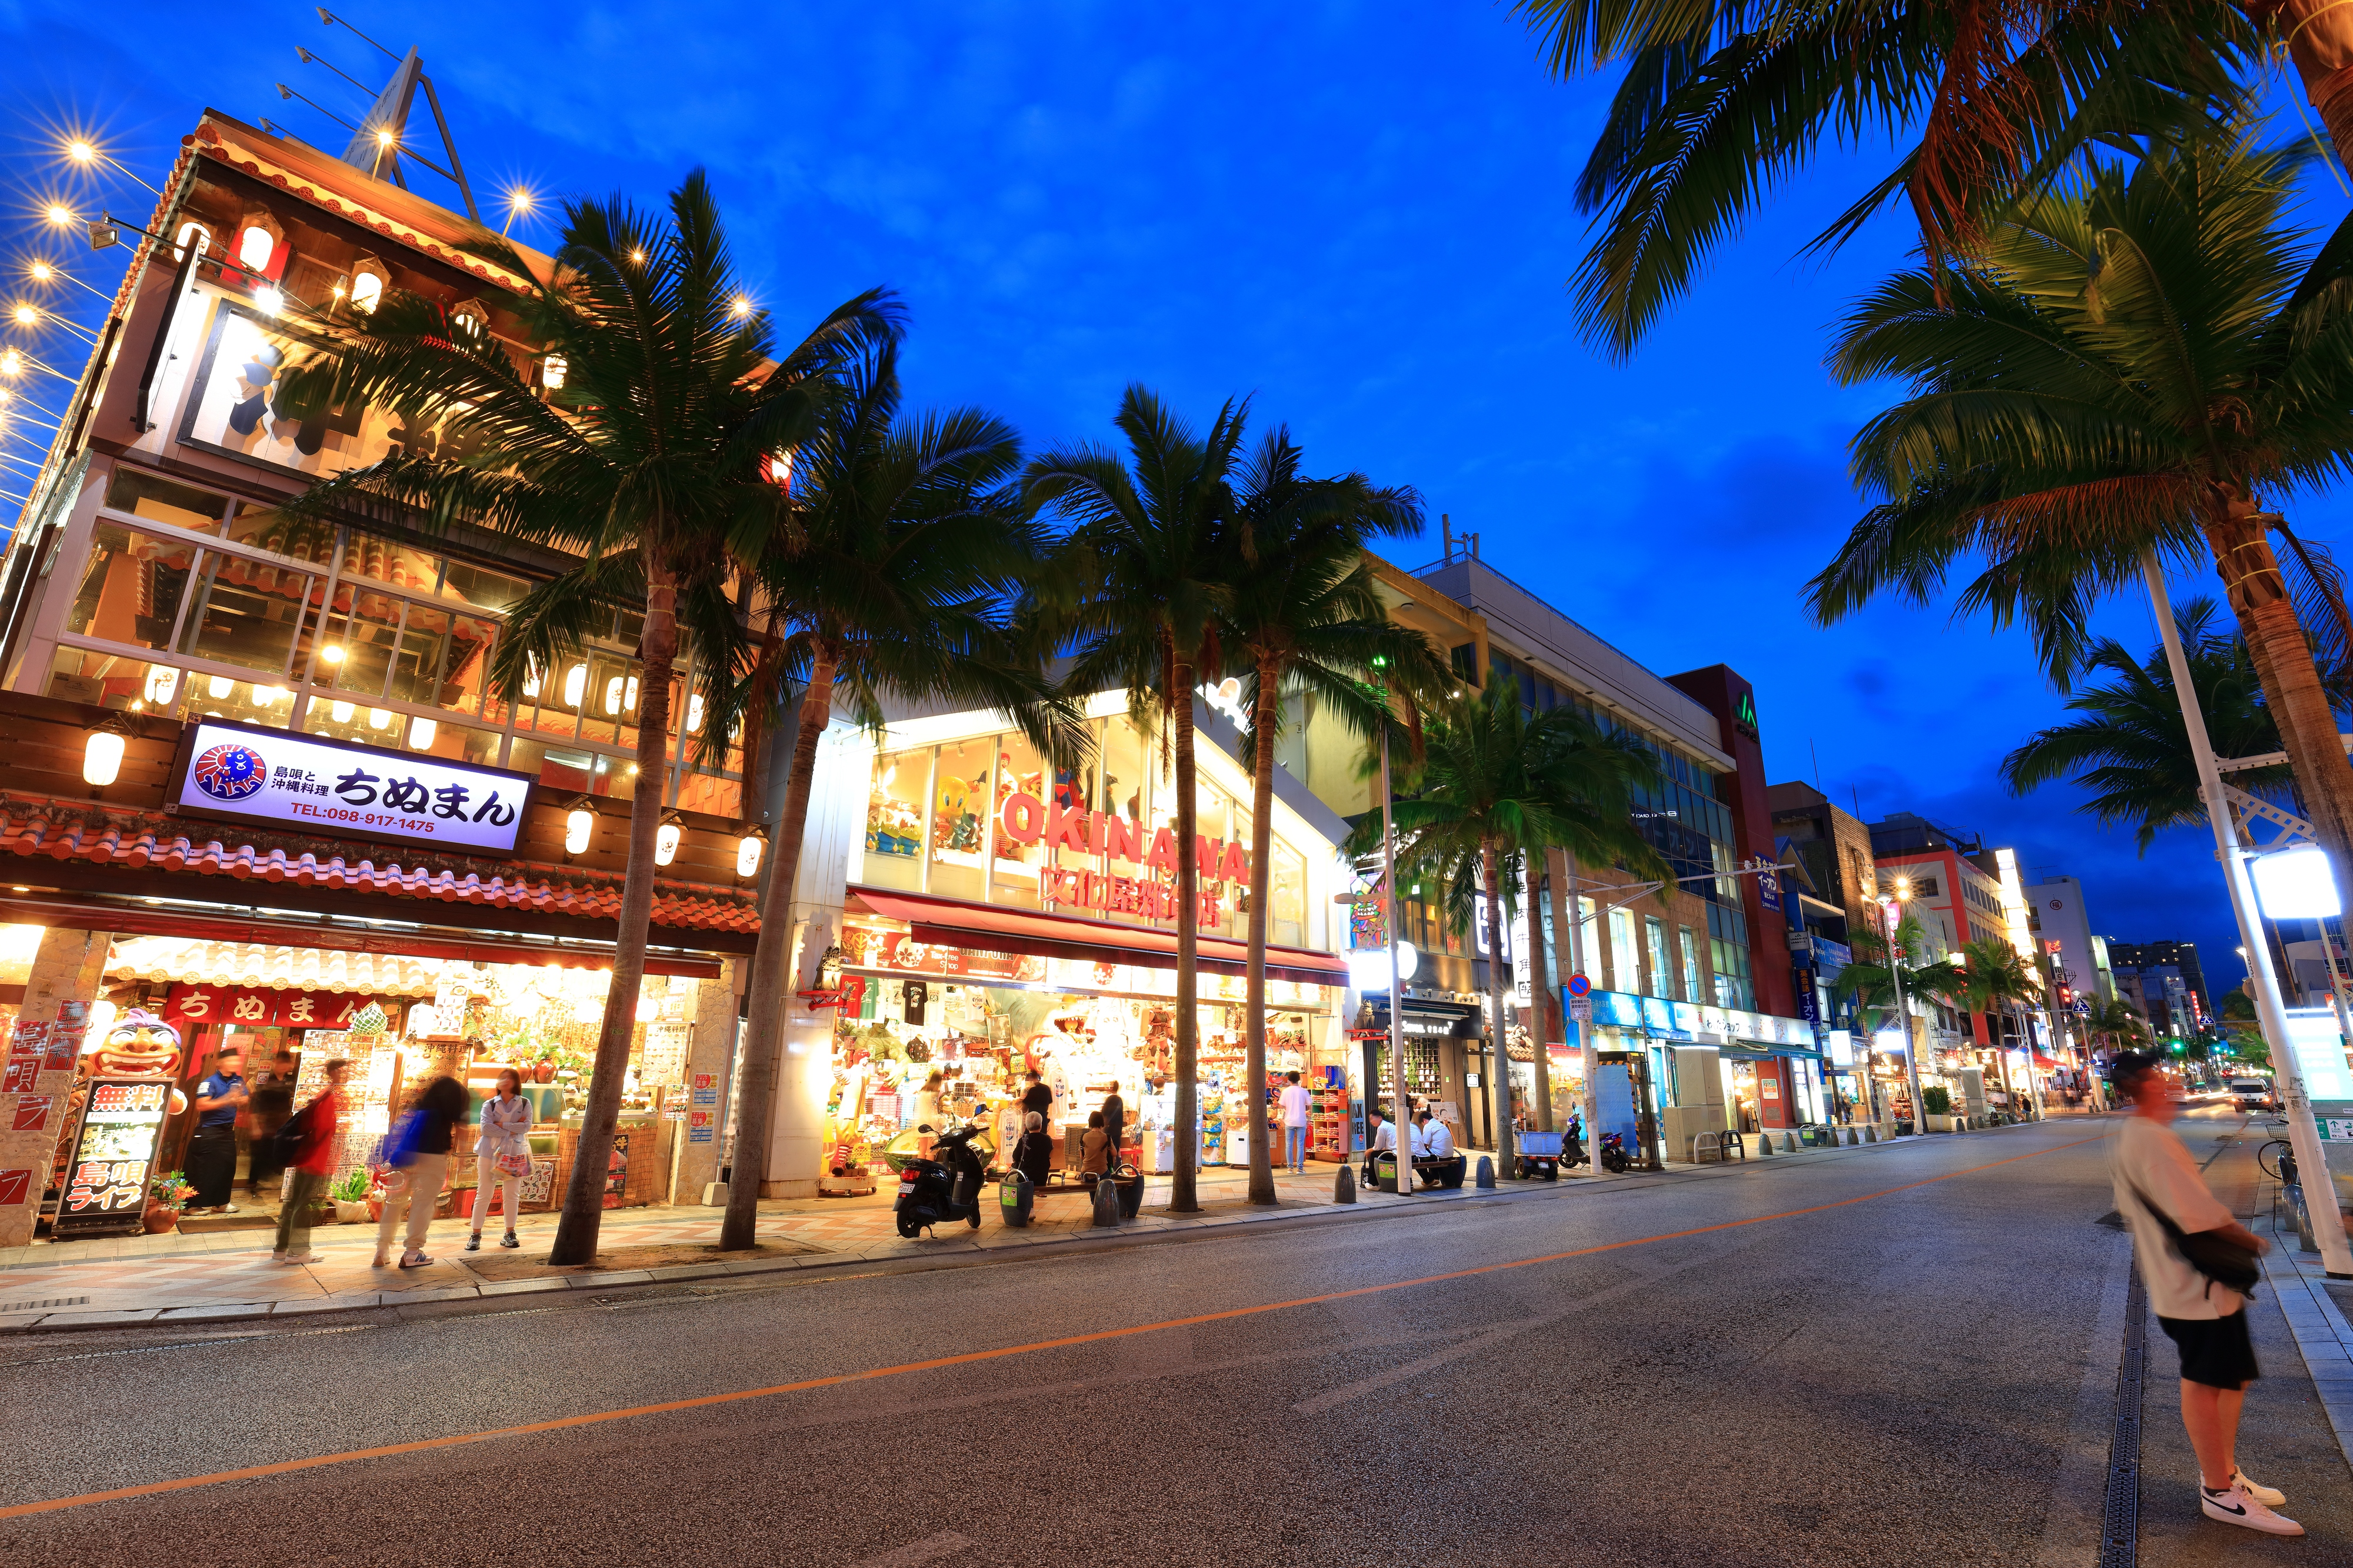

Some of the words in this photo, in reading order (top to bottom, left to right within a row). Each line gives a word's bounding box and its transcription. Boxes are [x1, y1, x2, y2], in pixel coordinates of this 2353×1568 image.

[271, 778, 329, 797] 沖縄料理
[273, 766, 316, 782] 島唄と
[334, 768, 515, 827] ちぬまん
[291, 802, 435, 833] TEL:098-917-1475
[1001, 793, 1250, 886] OKINAWA
[1758, 874, 1777, 891] イーオン
[1799, 970, 1810, 993] 英会話
[1802, 992, 1814, 1021] イーオン
[47, 1002, 86, 1068] 無料
[91, 1084, 166, 1112] 無料
[71, 1160, 149, 1187] 島唄
[66, 1185, 142, 1212] ライブ
